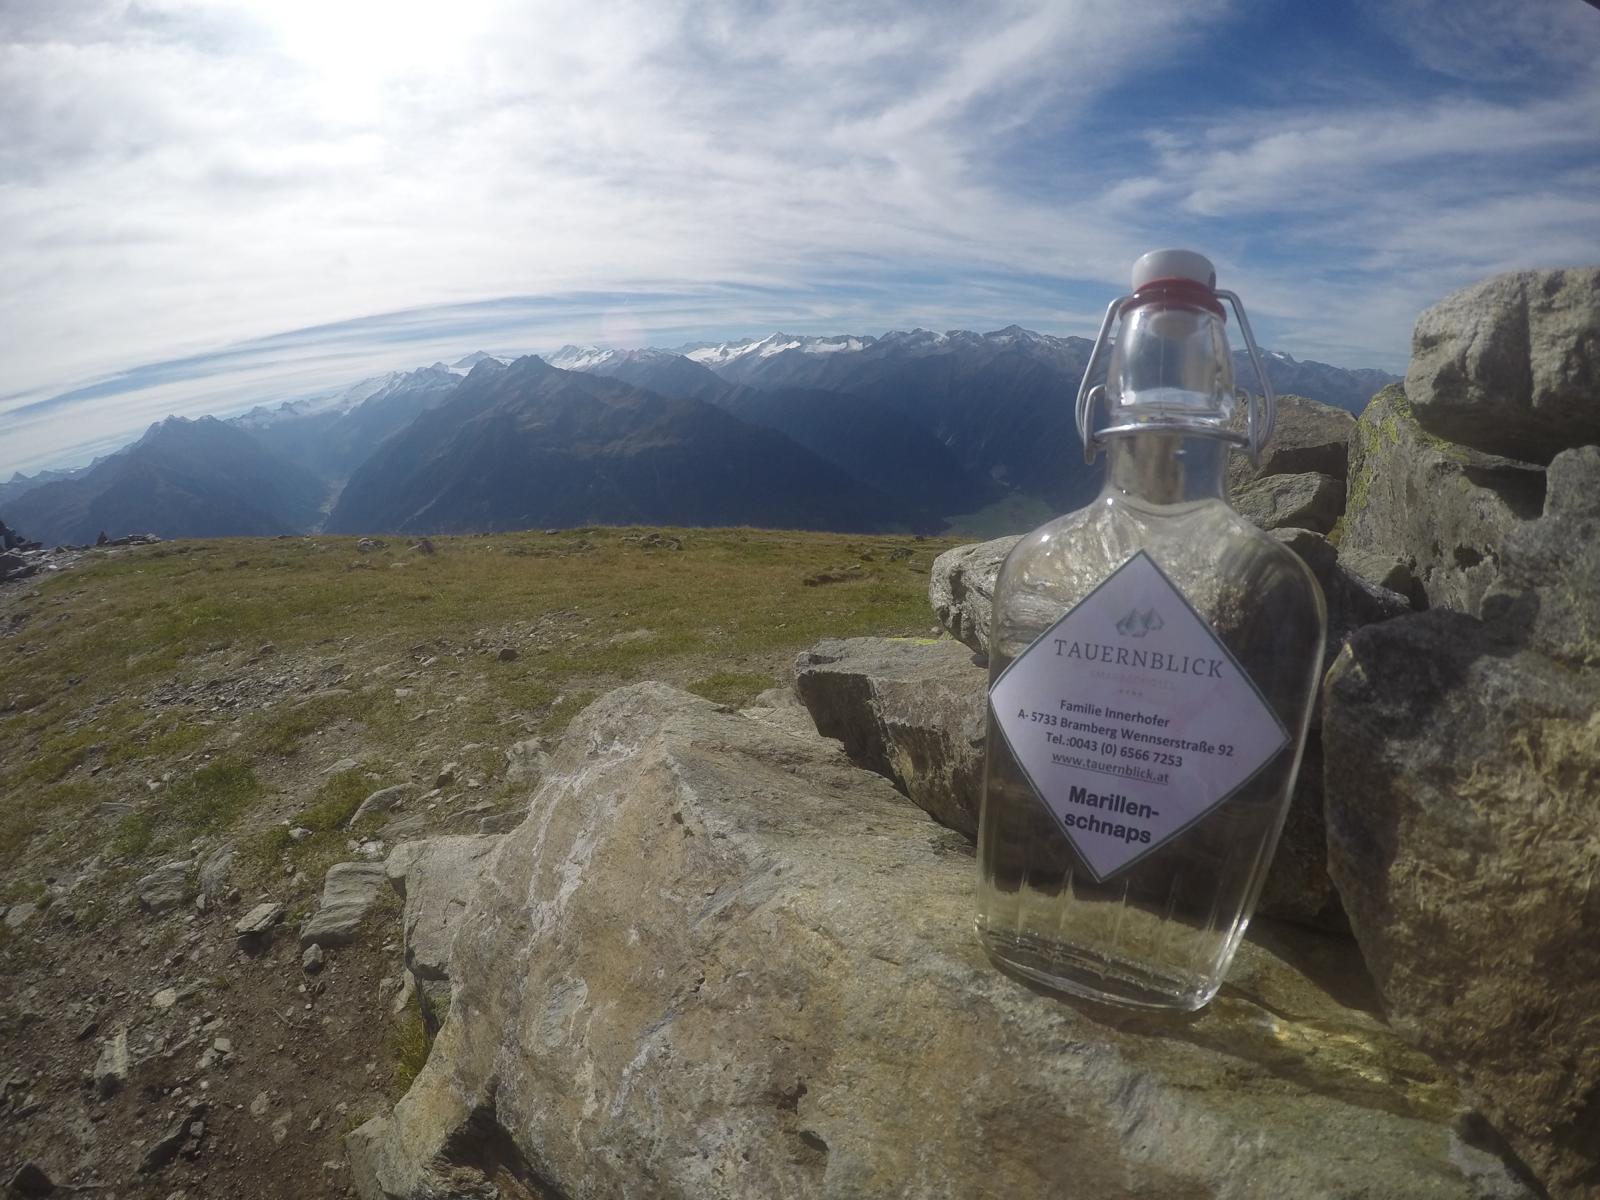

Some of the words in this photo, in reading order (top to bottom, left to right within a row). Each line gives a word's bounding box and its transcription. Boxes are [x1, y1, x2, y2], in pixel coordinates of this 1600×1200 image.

[1054, 639, 1224, 679] TAUERNBLICK
[1060, 699, 1102, 717] Familie
[1105, 703, 1170, 728] Innerhofer
[1031, 711, 1057, 726] 5733
[1060, 719, 1118, 739] Bramberg
[1120, 727, 1215, 754] Wennserstraße
[1218, 744, 1235, 757] 92
[1046, 732, 1098, 752] Tel.:0043
[1100, 742, 1118, 757] (0)
[1120, 746, 1150, 761] 6566
[1153, 752, 1183, 767] 7253
[1051, 753, 1169, 783] www.tauernblick.at
[1069, 785, 1160, 819] Marillen-
[1064, 813, 1152, 844] schnaps
